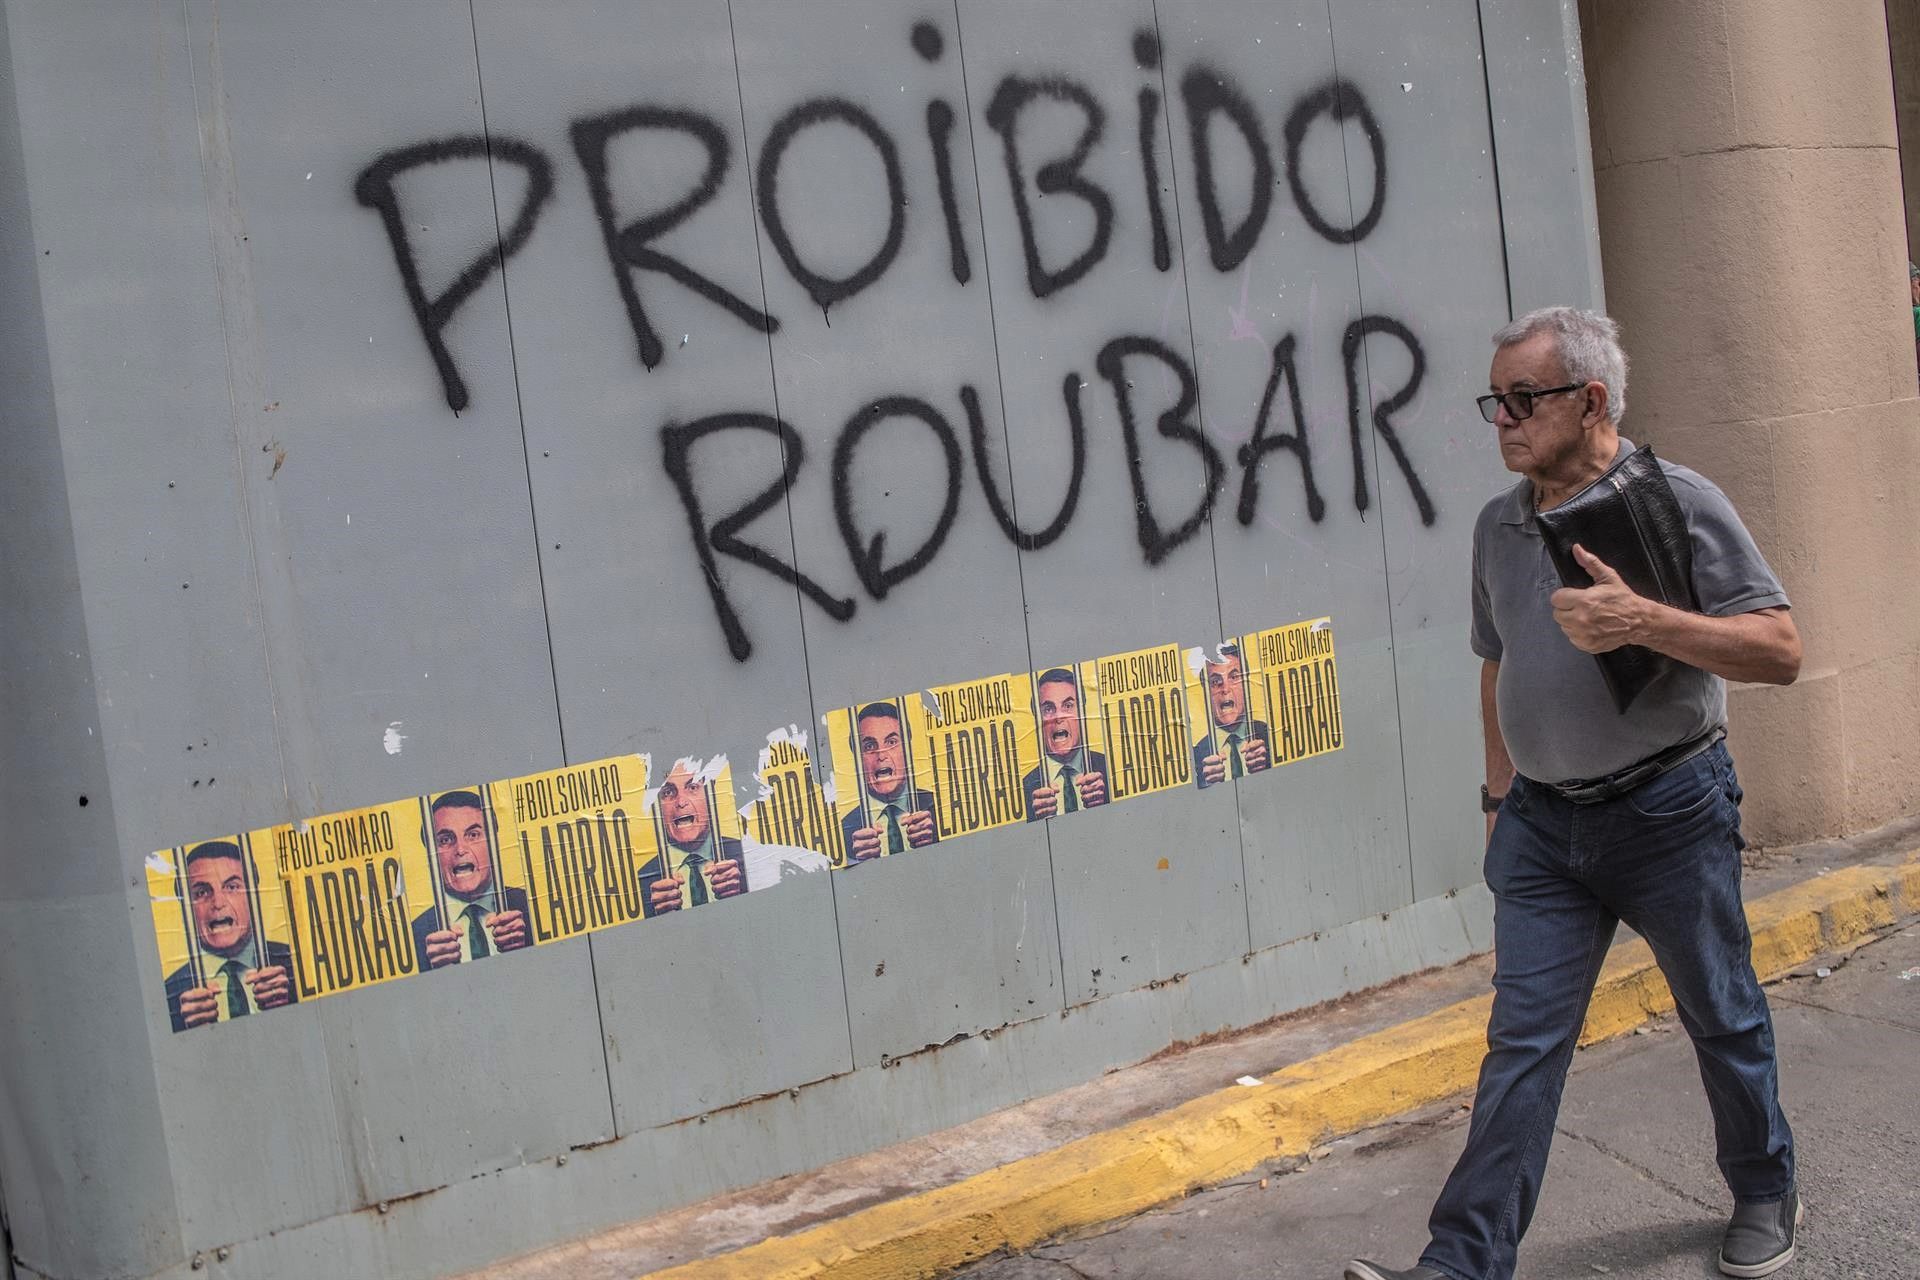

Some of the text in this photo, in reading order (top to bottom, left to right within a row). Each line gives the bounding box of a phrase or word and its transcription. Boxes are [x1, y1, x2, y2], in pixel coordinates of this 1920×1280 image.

[660, 314, 1436, 661] ROUBAR
[1100, 649, 1179, 697] #BOLSONARO
[1262, 625, 1332, 668] #BOLSONARO
[1103, 687, 1190, 799] LADRÃO
[1265, 658, 1342, 764] LADRÃO
[515, 763, 623, 823] #BOLSONARO
[929, 719, 1024, 838] LADRÃO
[278, 810, 395, 873] #BOLSONARO
[520, 808, 641, 942] LADRÃO
[284, 857, 415, 998] LADRÃO
